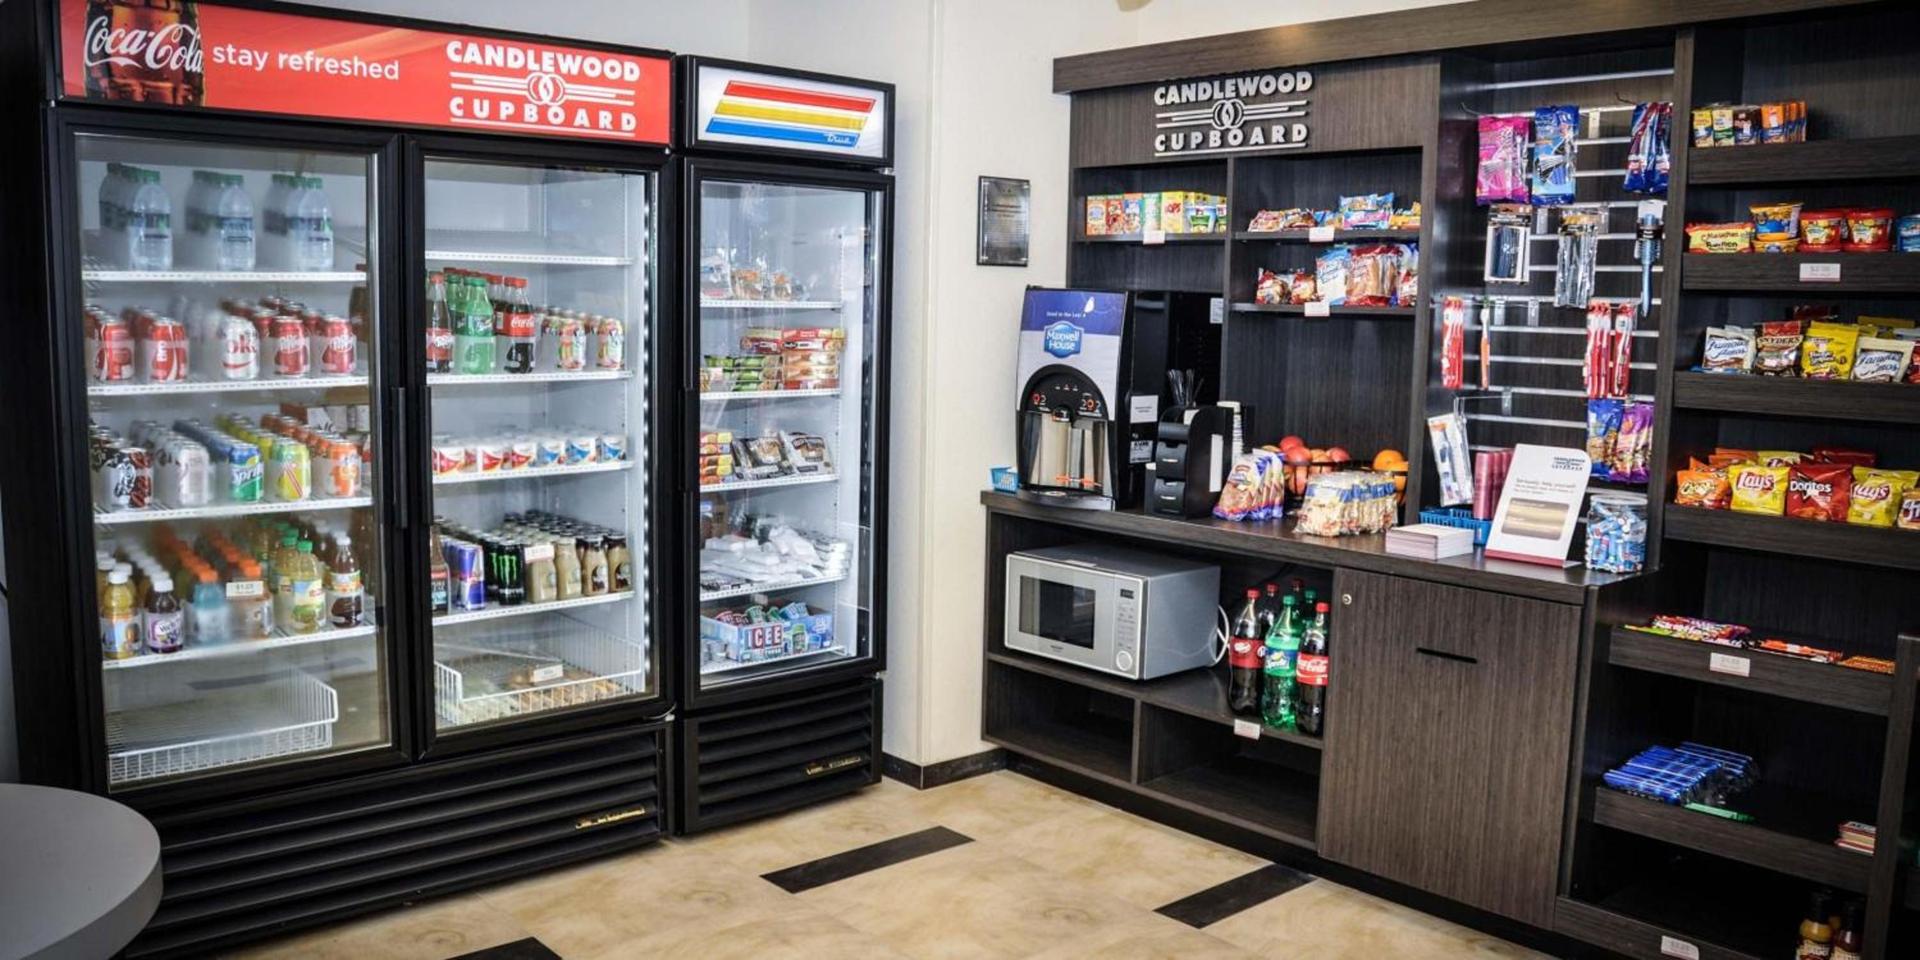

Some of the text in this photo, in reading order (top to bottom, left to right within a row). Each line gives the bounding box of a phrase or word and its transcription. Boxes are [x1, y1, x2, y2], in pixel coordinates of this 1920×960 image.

[85, 16, 203, 73] Coca-Cola
[212, 44, 399, 80] stay refreshed
[446, 41, 641, 82] CANDLEWOOD
[1154, 71, 1313, 106] CANDLEWOOD
[449, 97, 637, 131] CUPBOARD
[1154, 123, 1308, 151] CUPBOARD
[1046, 330, 1080, 342] Maxwell
[1049, 340, 1076, 351] House
[1790, 480, 1832, 493] Doritos
[743, 624, 782, 649] ICEE
